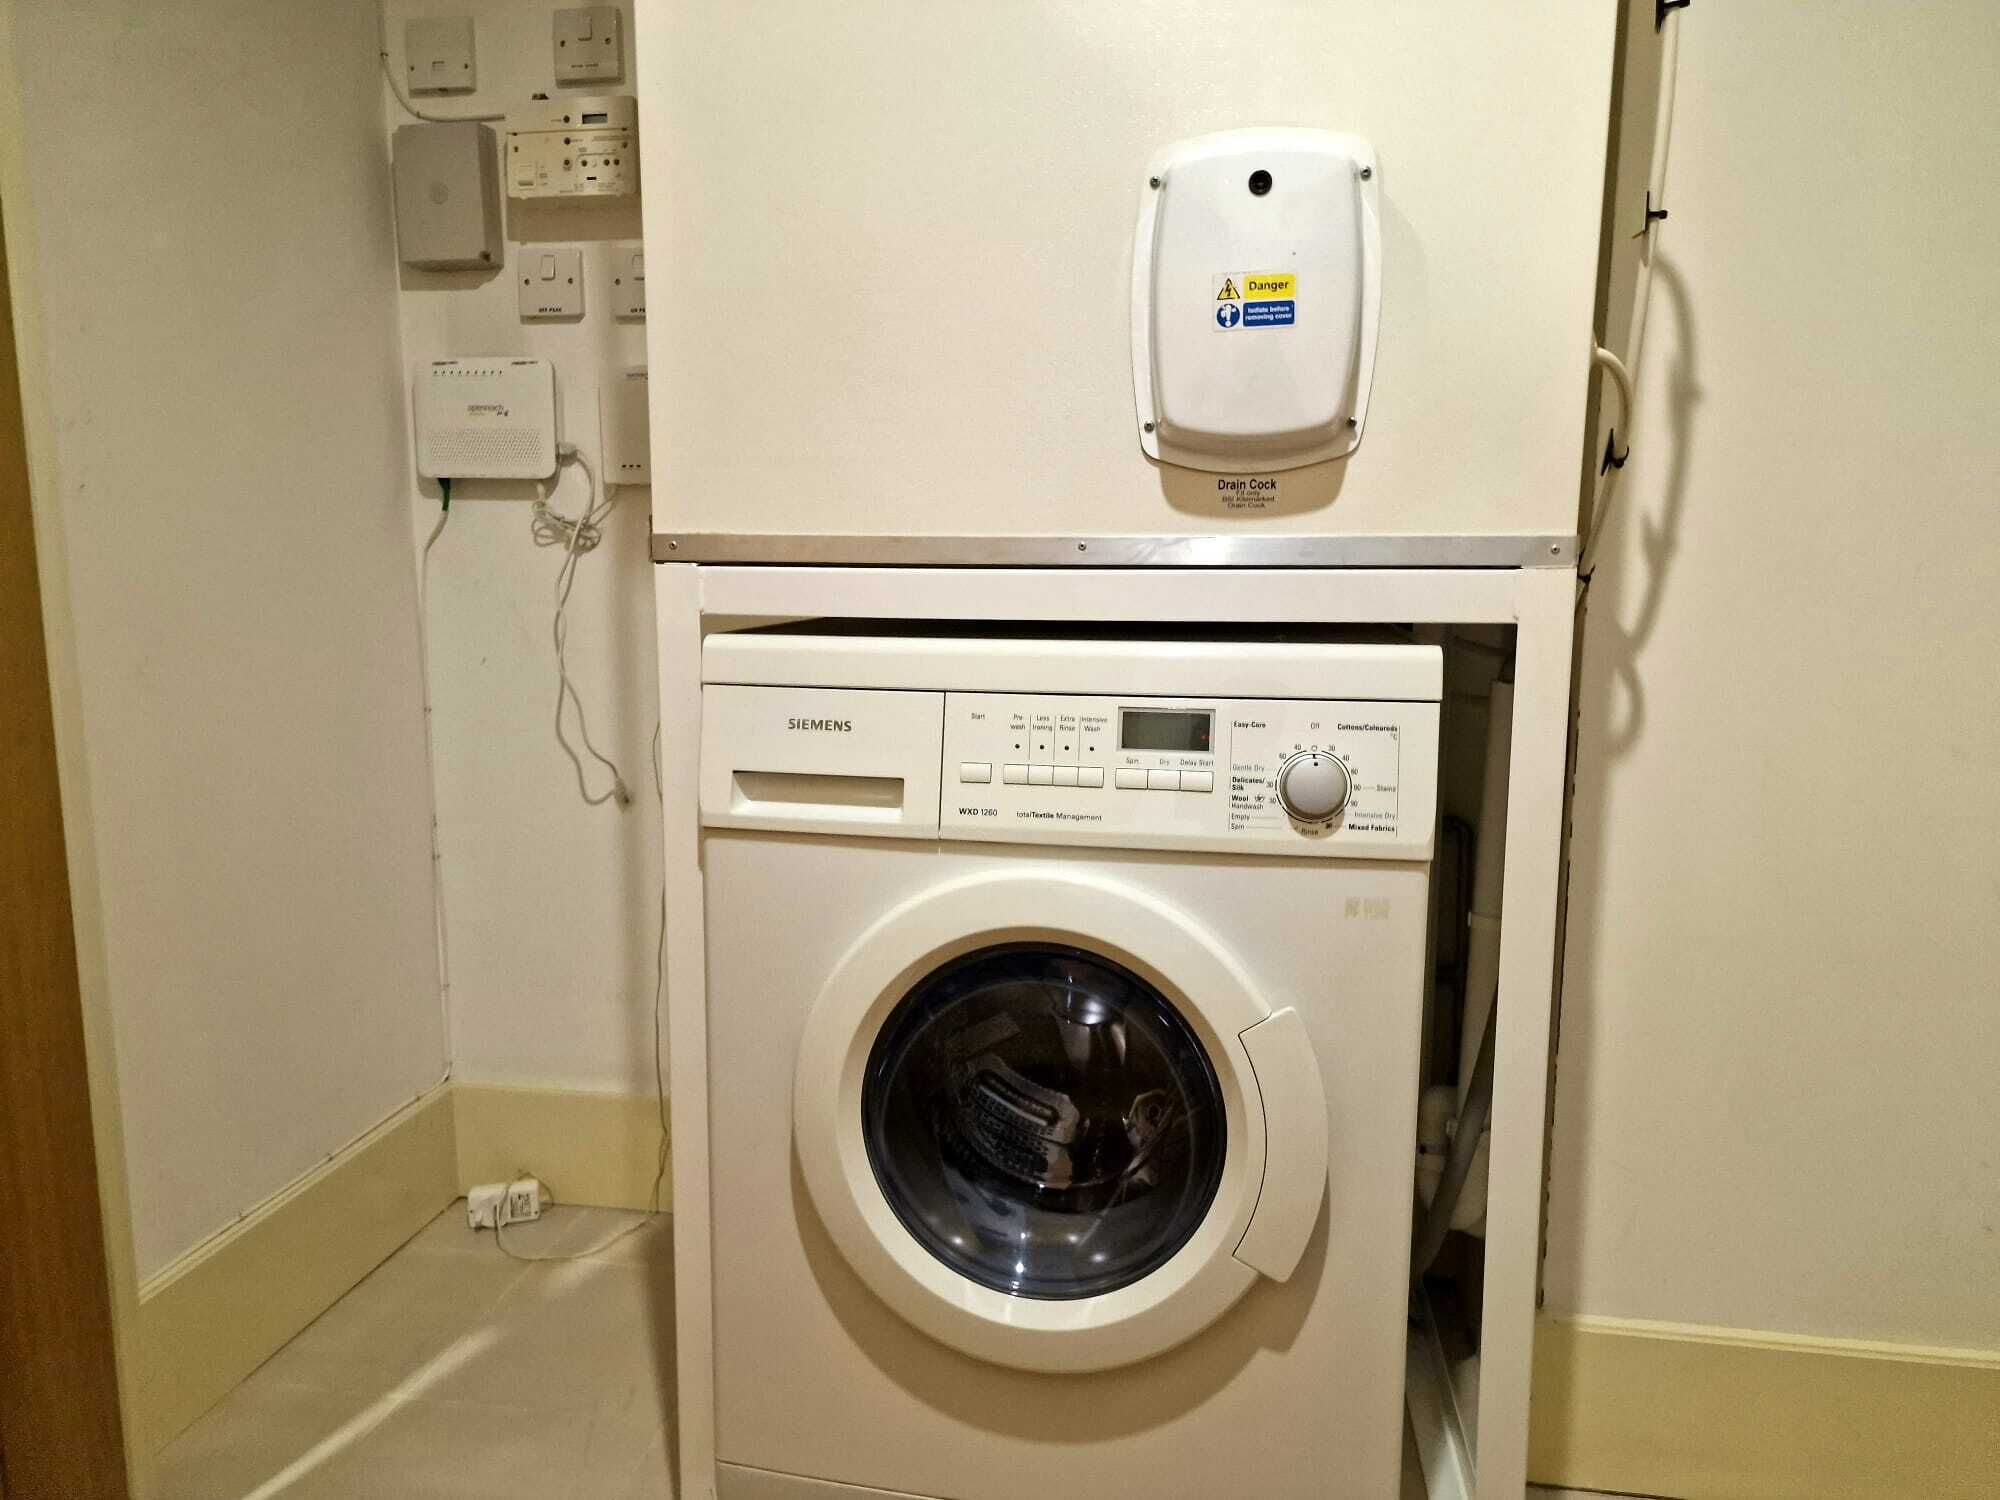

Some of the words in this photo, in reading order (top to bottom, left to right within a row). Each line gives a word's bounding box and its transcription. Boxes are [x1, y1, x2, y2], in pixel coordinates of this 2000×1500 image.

[1249, 281, 1289, 292] Danger
[1269, 305, 1290, 313] before
[1245, 313, 1274, 321] removing
[1218, 479, 1246, 490] Drain
[1249, 479, 1277, 490] Cock
[971, 712, 986, 720] Start
[1013, 713, 1023, 721] Pre
[1036, 714, 1050, 722] Less
[1060, 715, 1076, 723] Extra
[788, 718, 852, 732] SIEMENS
[1059, 724, 1076, 732] Rinse
[1337, 723, 1398, 732] Cottons/Coloureds
[1125, 757, 1140, 765] Spin
[1159, 758, 1170, 766] Dry
[1180, 758, 1197, 767] Delay
[1254, 765, 1265, 773] Dry
[1232, 776, 1265, 784] Delicates/
[958, 807, 979, 816] WXD
[980, 808, 998, 817] 1260
[1384, 812, 1396, 820] Dry
[1056, 812, 1102, 822] Management
[1231, 813, 1250, 821] Empty
[1231, 822, 1245, 831] Spin
[1348, 823, 1370, 831] Mixed
[1371, 824, 1395, 832] Fabrics
